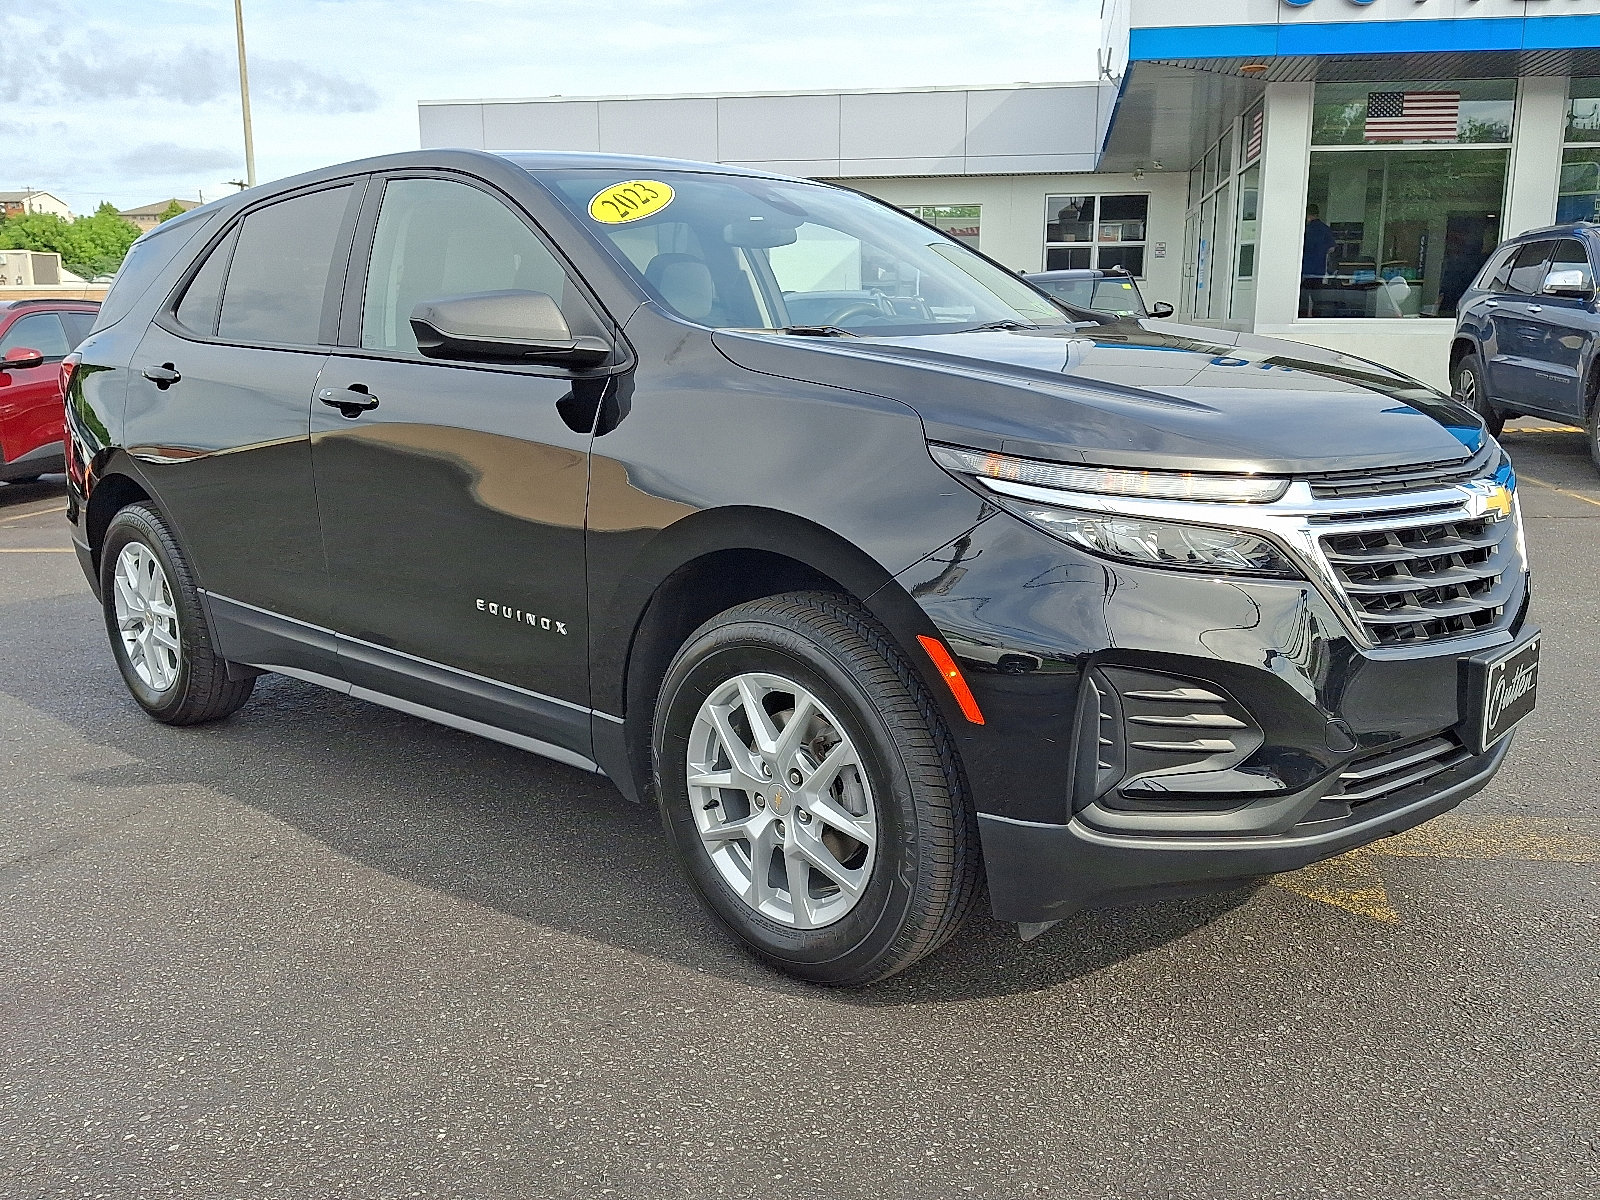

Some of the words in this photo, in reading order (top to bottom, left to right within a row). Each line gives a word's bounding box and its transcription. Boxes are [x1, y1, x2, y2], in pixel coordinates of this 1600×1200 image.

[601, 184, 659, 218] 2023
[475, 598, 568, 635] EQUINOX
[898, 790, 917, 872] ALENZA
